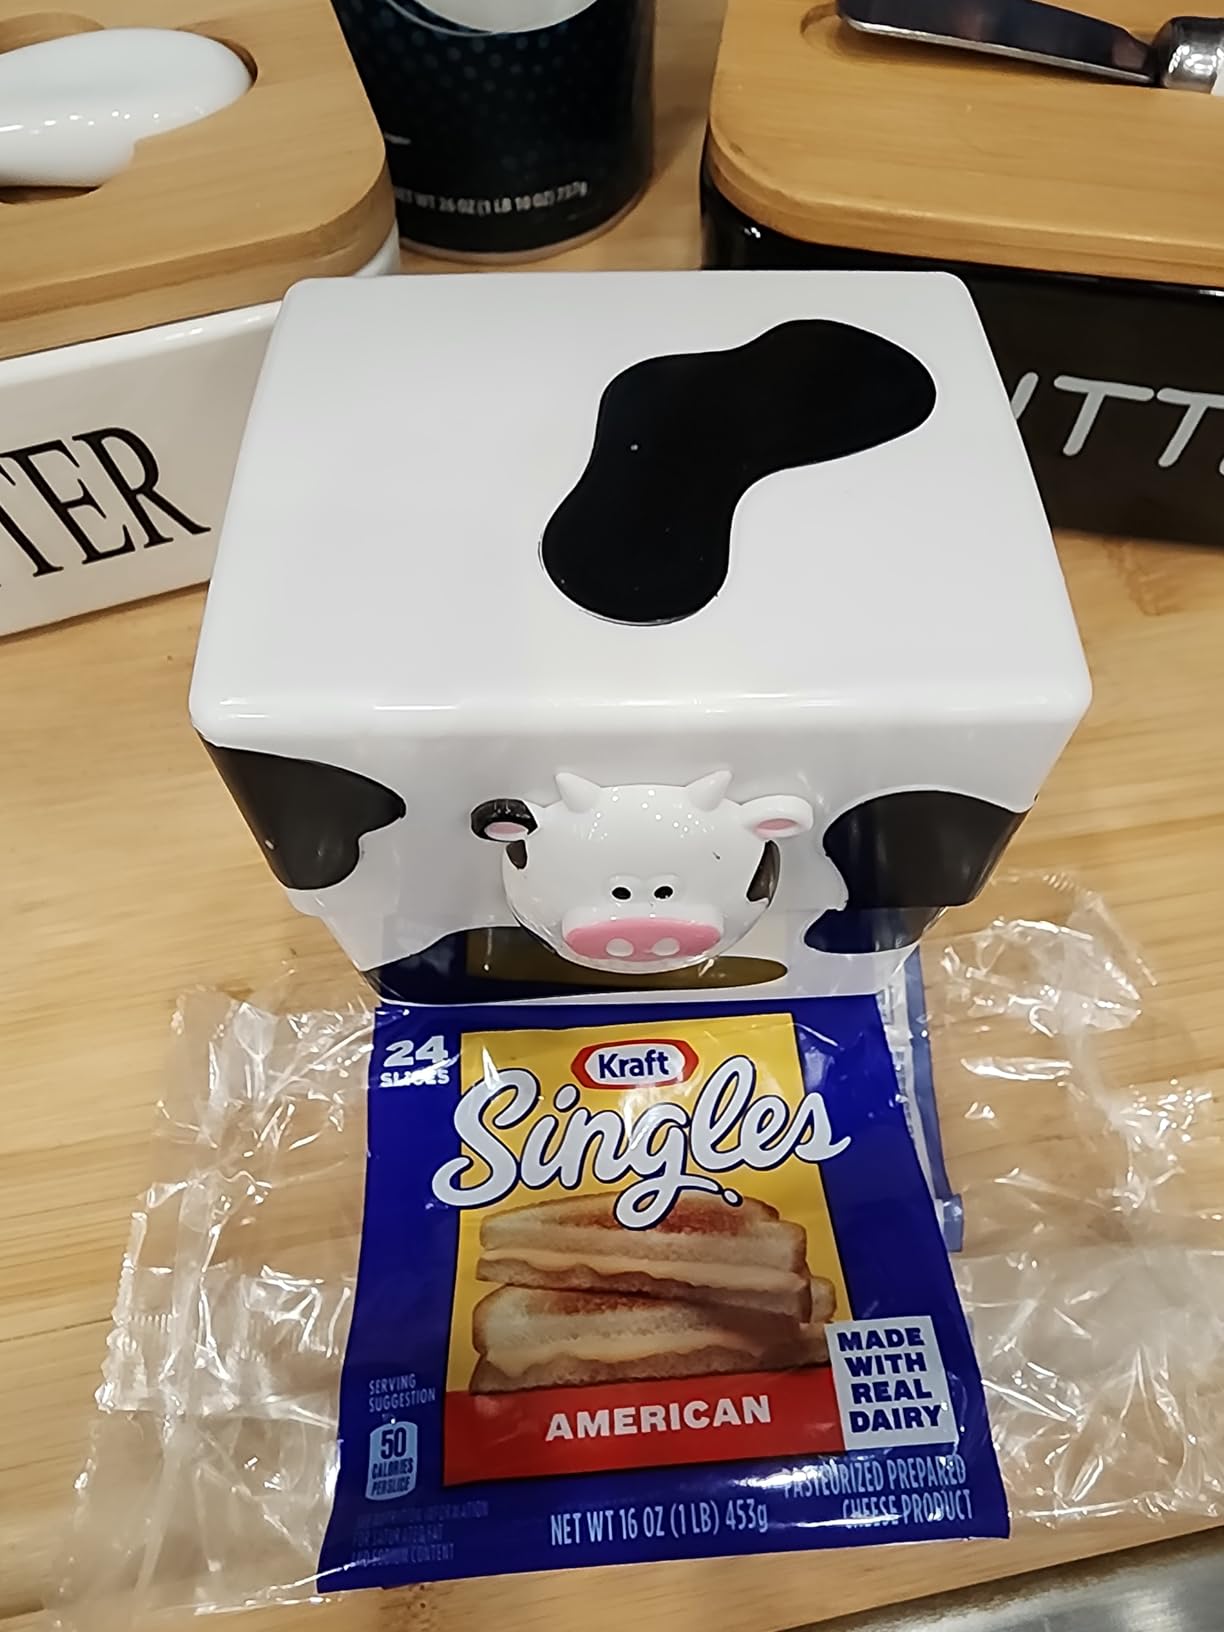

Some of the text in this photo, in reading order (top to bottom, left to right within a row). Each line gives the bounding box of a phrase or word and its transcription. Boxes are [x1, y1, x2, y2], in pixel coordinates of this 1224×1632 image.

[383, 1034, 449, 1068] 24
[598, 1049, 669, 1079] Kraft
[431, 1055, 852, 1230] Singles
[836, 1327, 926, 1352] MADE
[844, 1351, 928, 1378] WITH
[368, 1373, 417, 1396] SERVING
[850, 1378, 933, 1405] REAL
[368, 1388, 437, 1413] SUGGESTION
[545, 1395, 772, 1442] AMERICAN
[848, 1403, 942, 1434] DAIRY
[380, 1426, 408, 1460] 50
[371, 1457, 414, 1480] CALORIES
[886, 1453, 967, 1491] PREPARED
[551, 1498, 769, 1546] NET WT 16 OZ (1 LB) 453g
[842, 1488, 974, 1530] CHEESE PRODUCT
